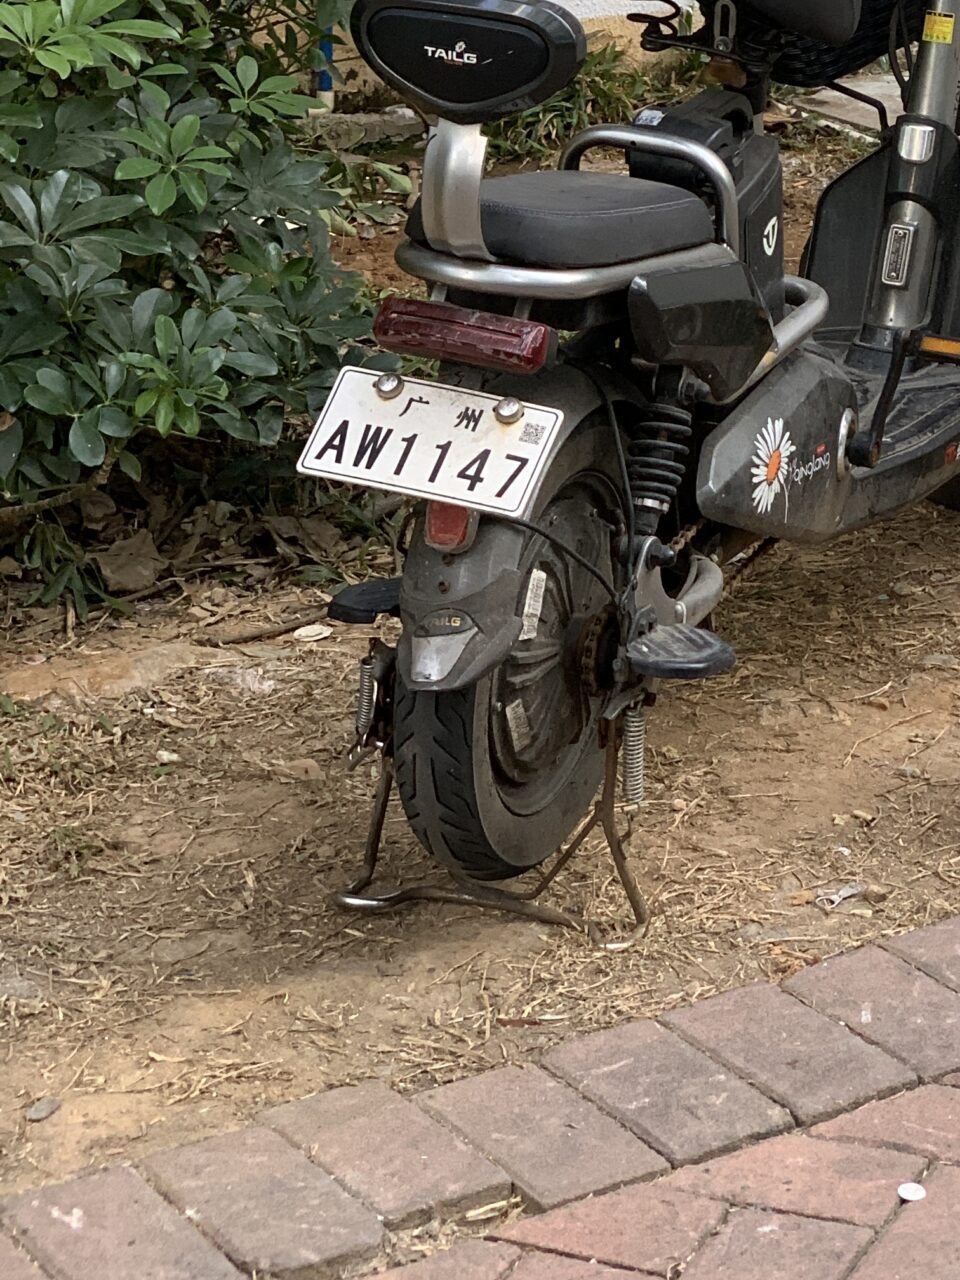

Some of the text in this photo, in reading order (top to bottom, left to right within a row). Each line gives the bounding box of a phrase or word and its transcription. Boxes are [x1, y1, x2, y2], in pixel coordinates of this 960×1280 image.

[423, 41, 478, 64] TAILG
[398, 395, 485, 433] 广州
[314, 419, 530, 499] AW1147
